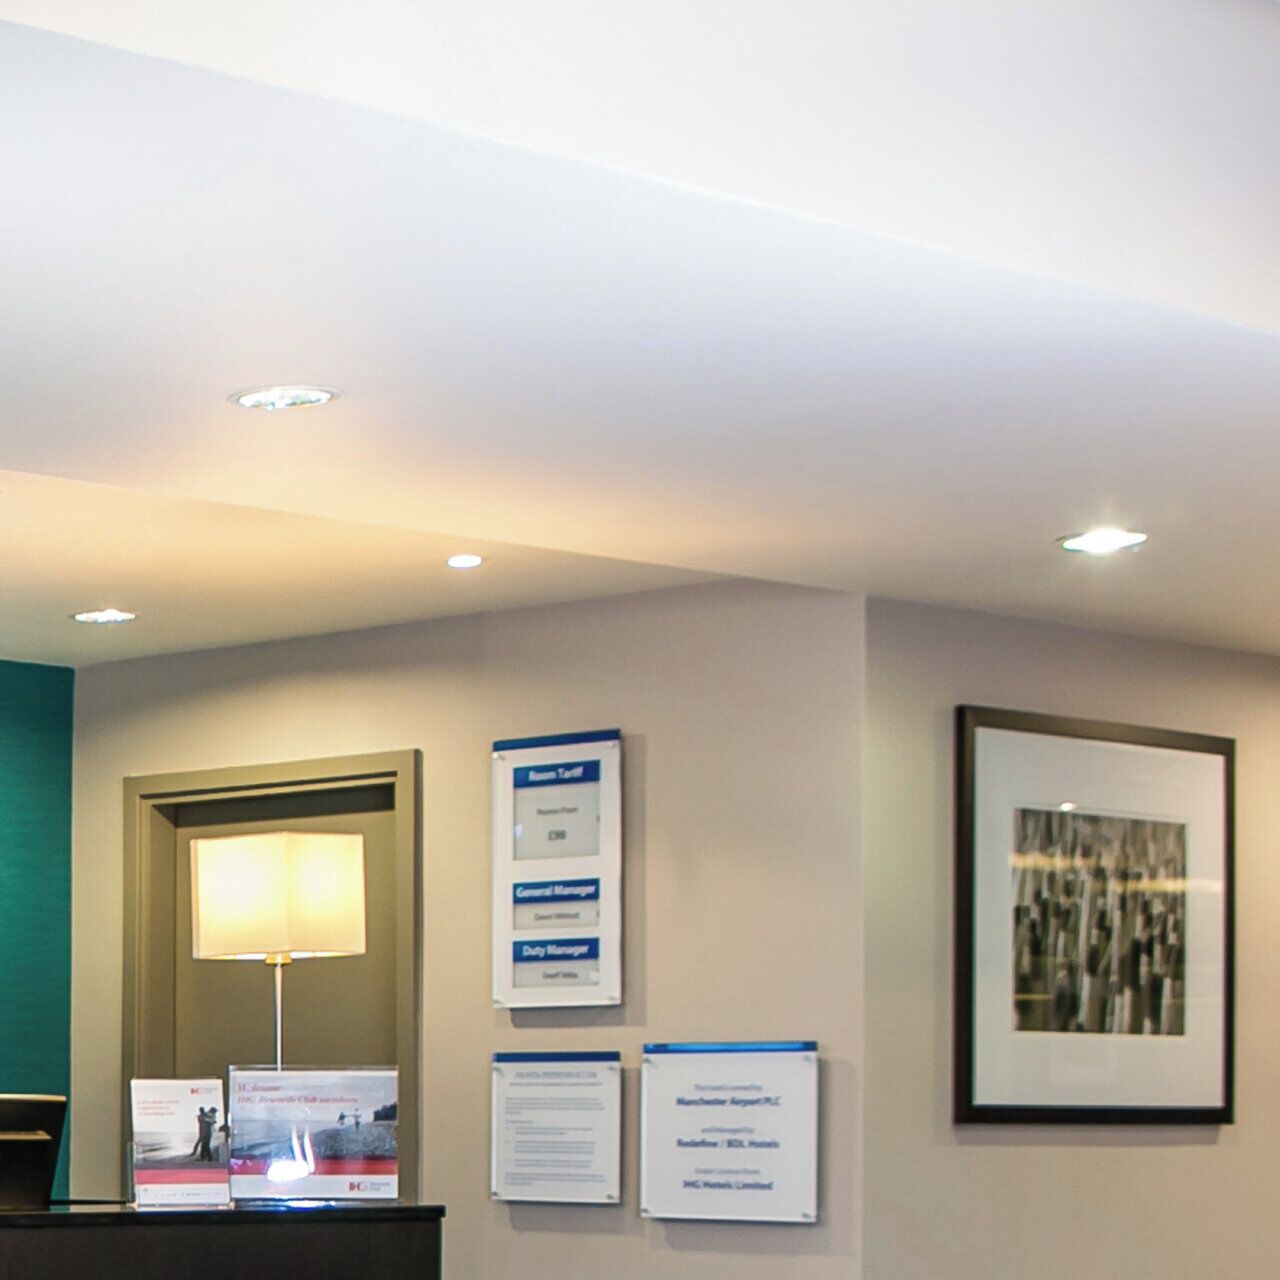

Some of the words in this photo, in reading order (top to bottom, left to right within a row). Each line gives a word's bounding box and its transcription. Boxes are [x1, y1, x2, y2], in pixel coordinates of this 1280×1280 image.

[528, 769, 557, 781] Room
[557, 765, 584, 779] Tariff
[516, 886, 553, 898] General
[554, 885, 596, 897] Manager
[523, 945, 546, 957] Duty
[547, 944, 589, 957] Manager
[676, 1096, 727, 1106] Manchester
